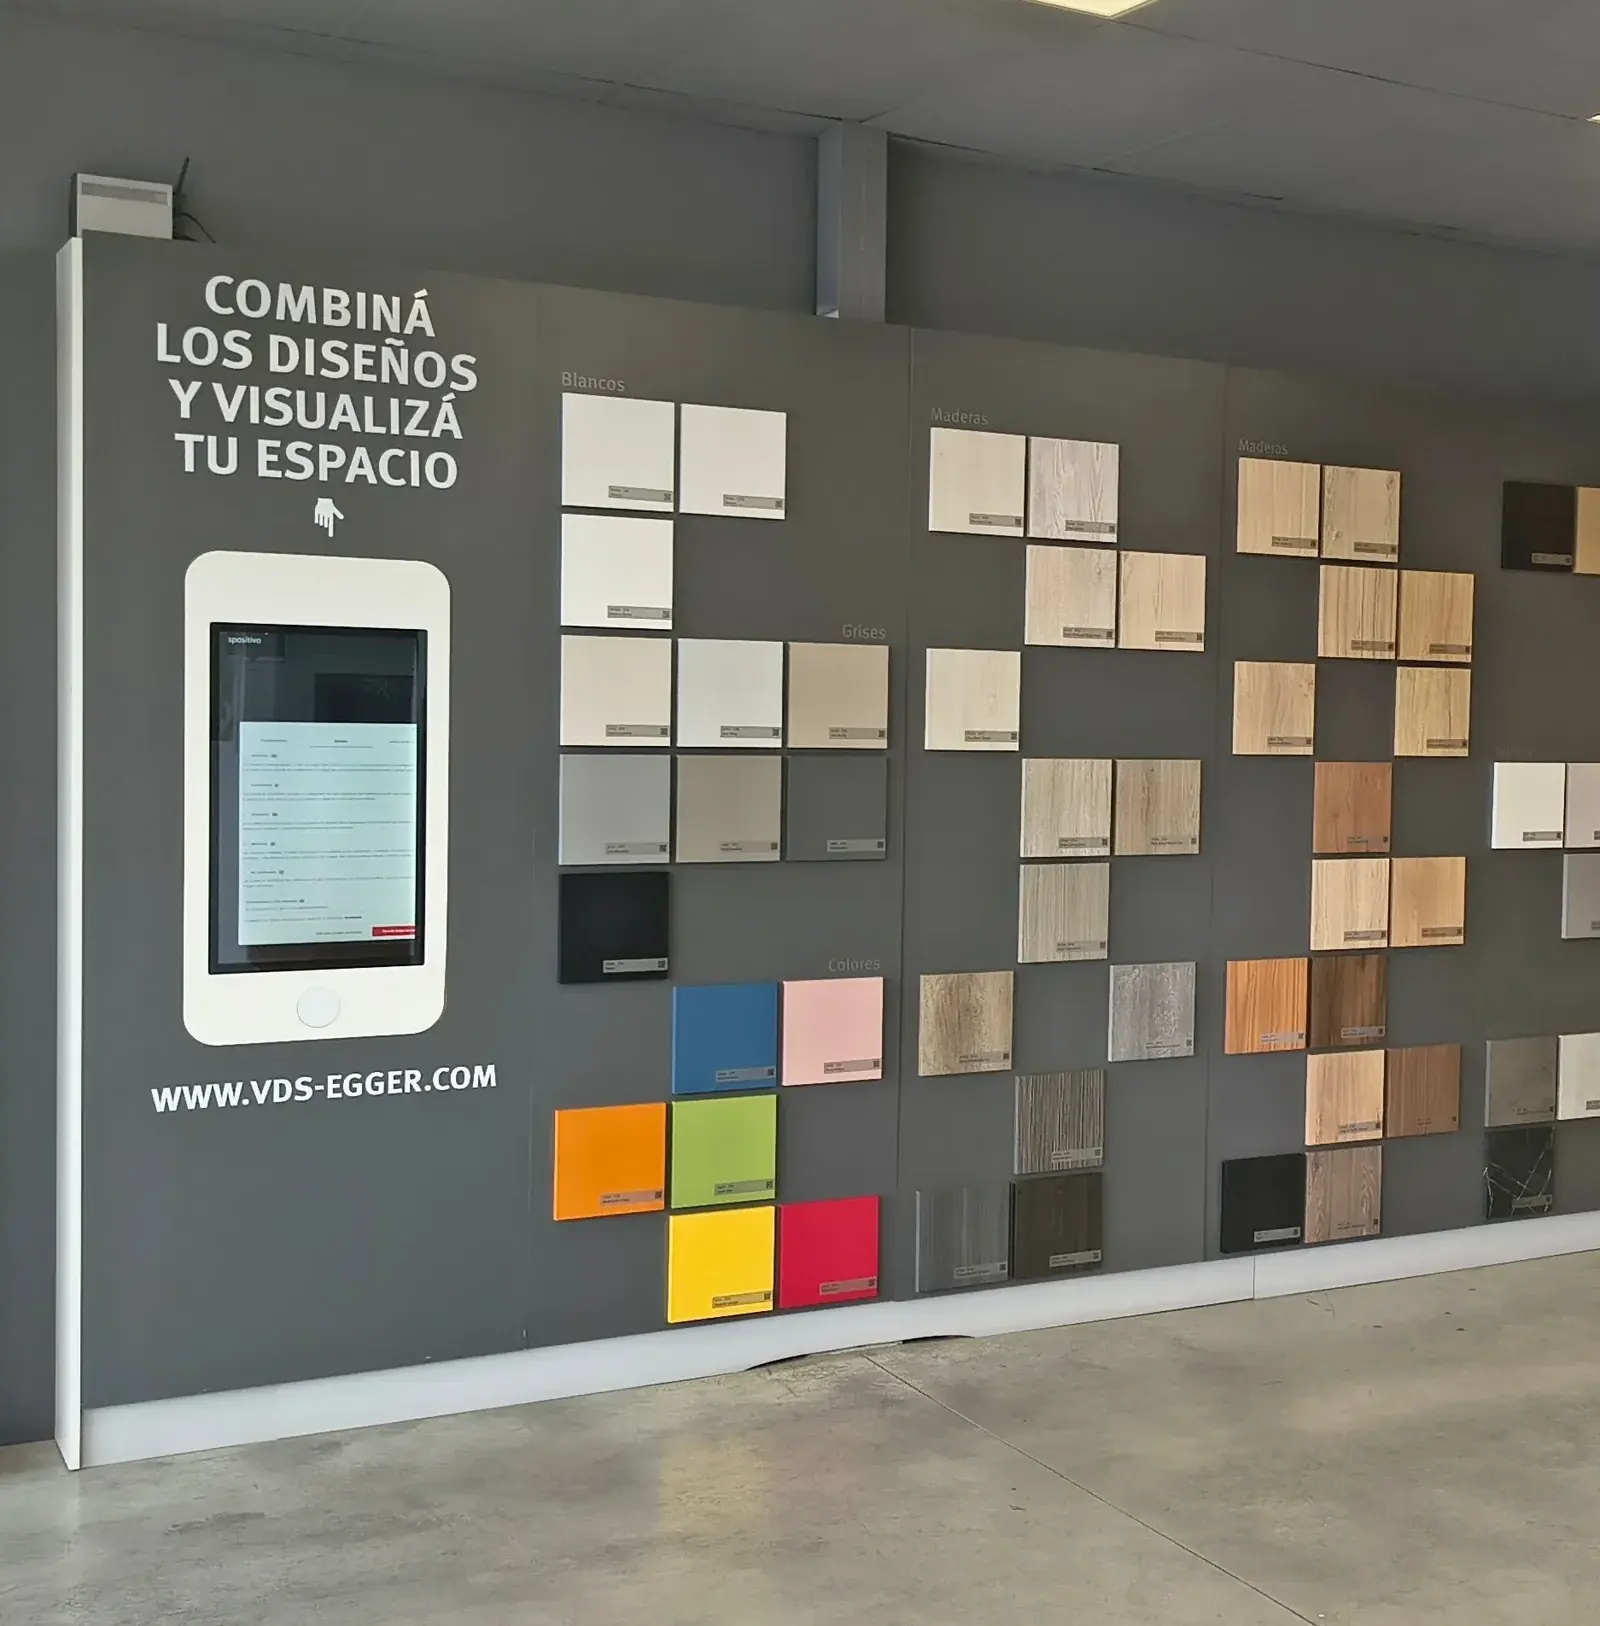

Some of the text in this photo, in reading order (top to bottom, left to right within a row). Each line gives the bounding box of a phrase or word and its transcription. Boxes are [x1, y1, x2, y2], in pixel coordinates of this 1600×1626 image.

[205, 275, 436, 337] COMBINÁ
[157, 323, 478, 392] LOS DISEÑOS
[562, 371, 626, 392] Blancos
[168, 378, 463, 440] Y VISUALIZÁ
[931, 407, 989, 425] Maderas
[174, 433, 459, 489] TU ESPACIO
[1238, 438, 1289, 456] Maderas
[842, 623, 887, 640] Grises
[828, 957, 881, 973] Colores
[151, 1064, 497, 1113] WWW.VDS-EGGER.COM
